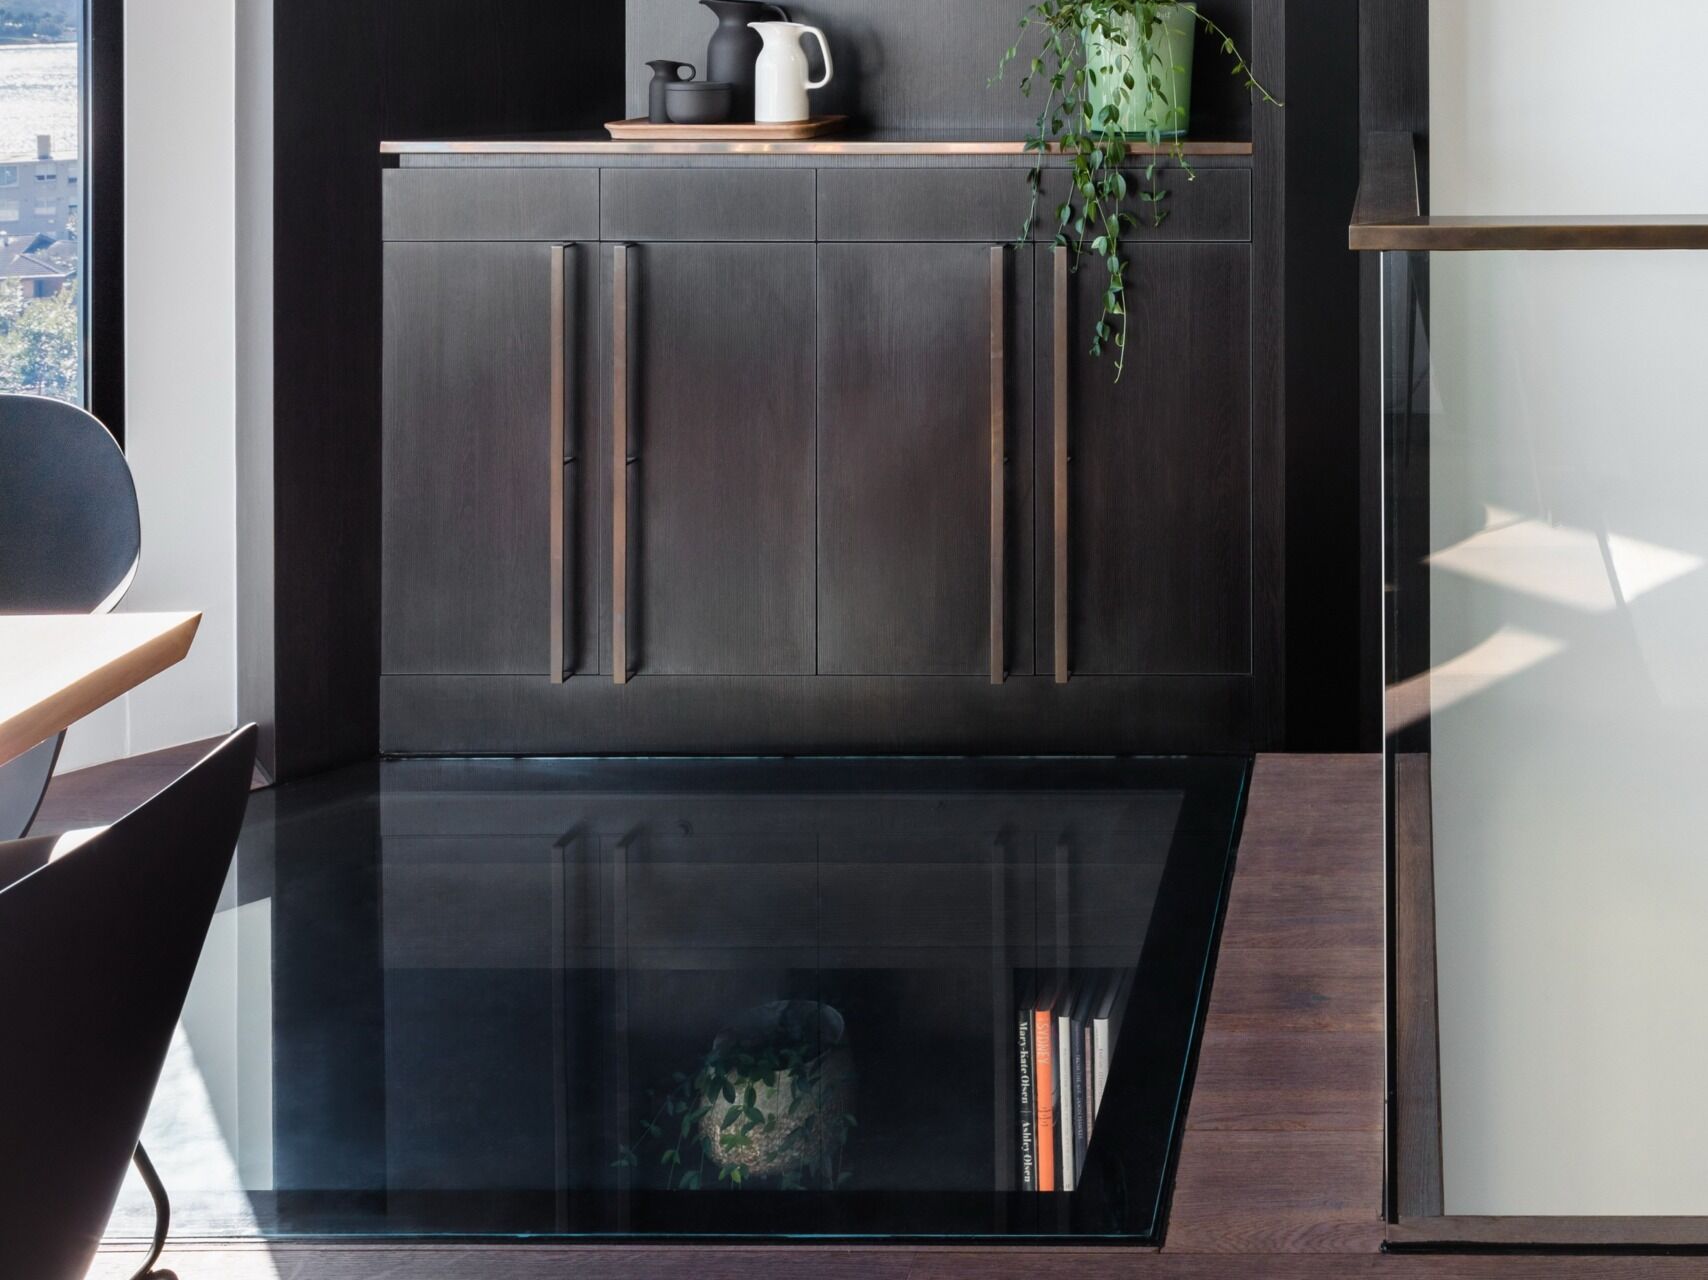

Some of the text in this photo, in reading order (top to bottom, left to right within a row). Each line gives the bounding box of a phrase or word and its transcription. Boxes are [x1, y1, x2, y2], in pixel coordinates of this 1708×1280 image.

[1037, 1023, 1049, 1064] SYDNEY
[1018, 1022, 1033, 1183] Mary-Kate Olsen Ashley Olsen
